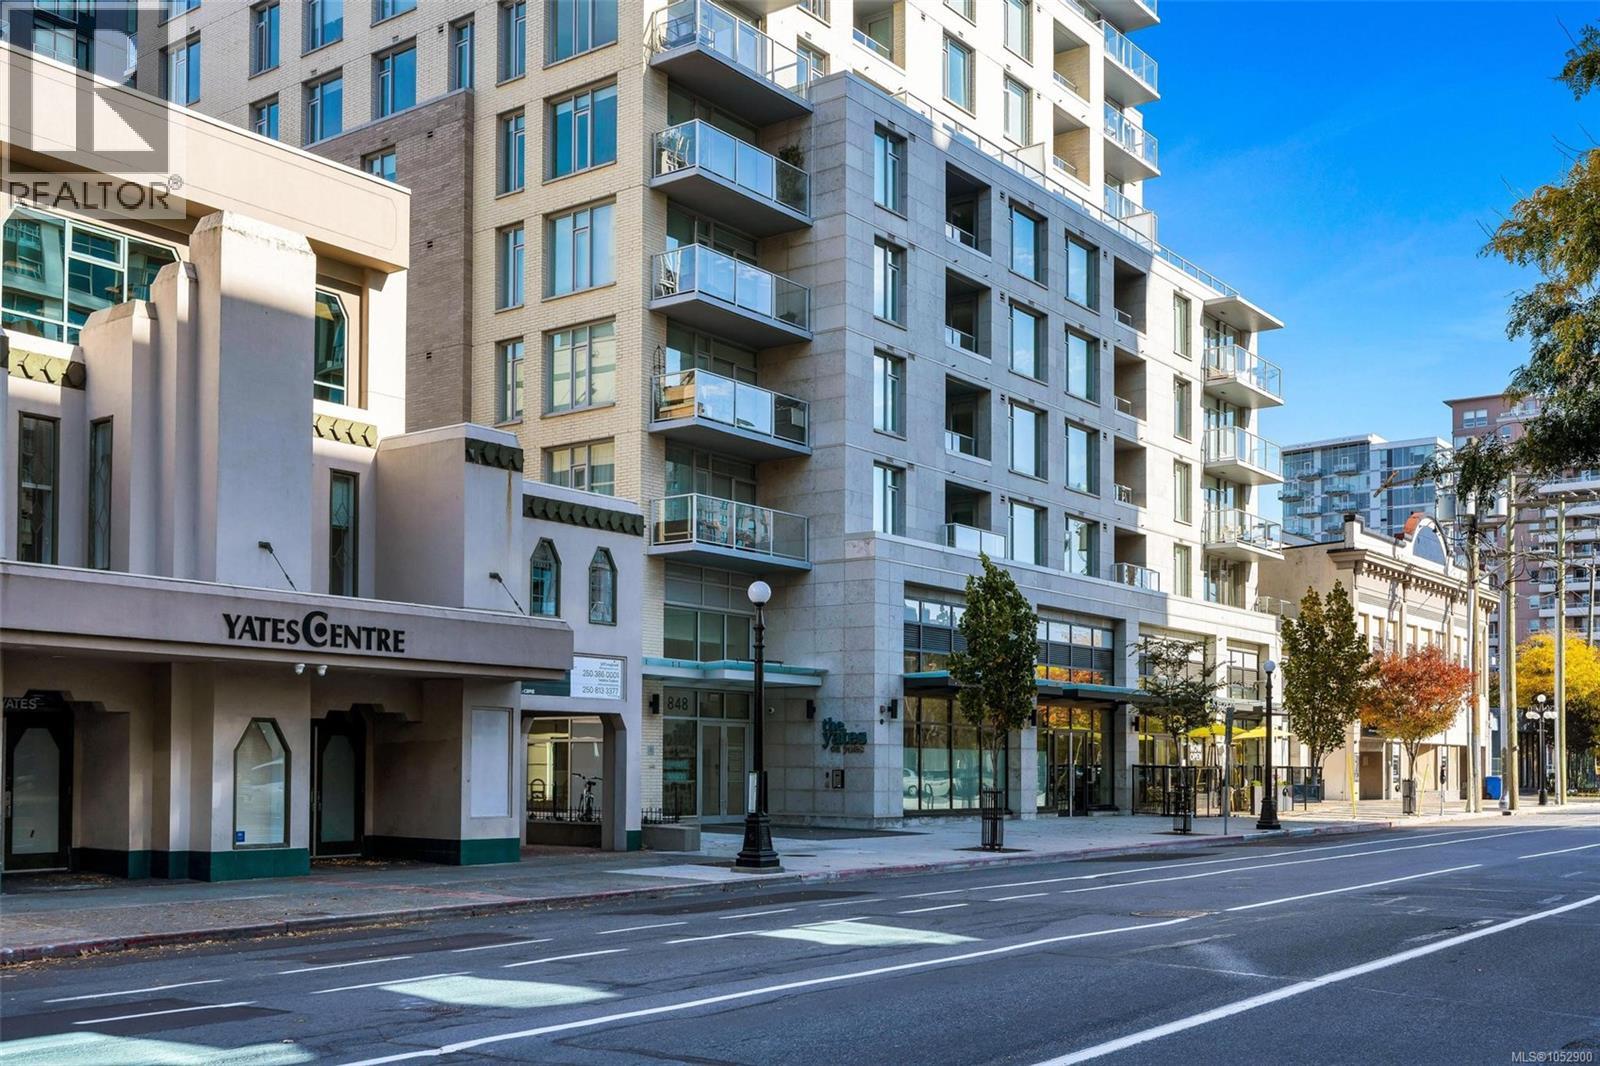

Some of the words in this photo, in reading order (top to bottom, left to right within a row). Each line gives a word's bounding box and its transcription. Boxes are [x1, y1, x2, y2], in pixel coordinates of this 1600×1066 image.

[582, 669, 594, 678] 250
[582, 686, 594, 694] 250
[667, 696, 689, 711] 848
